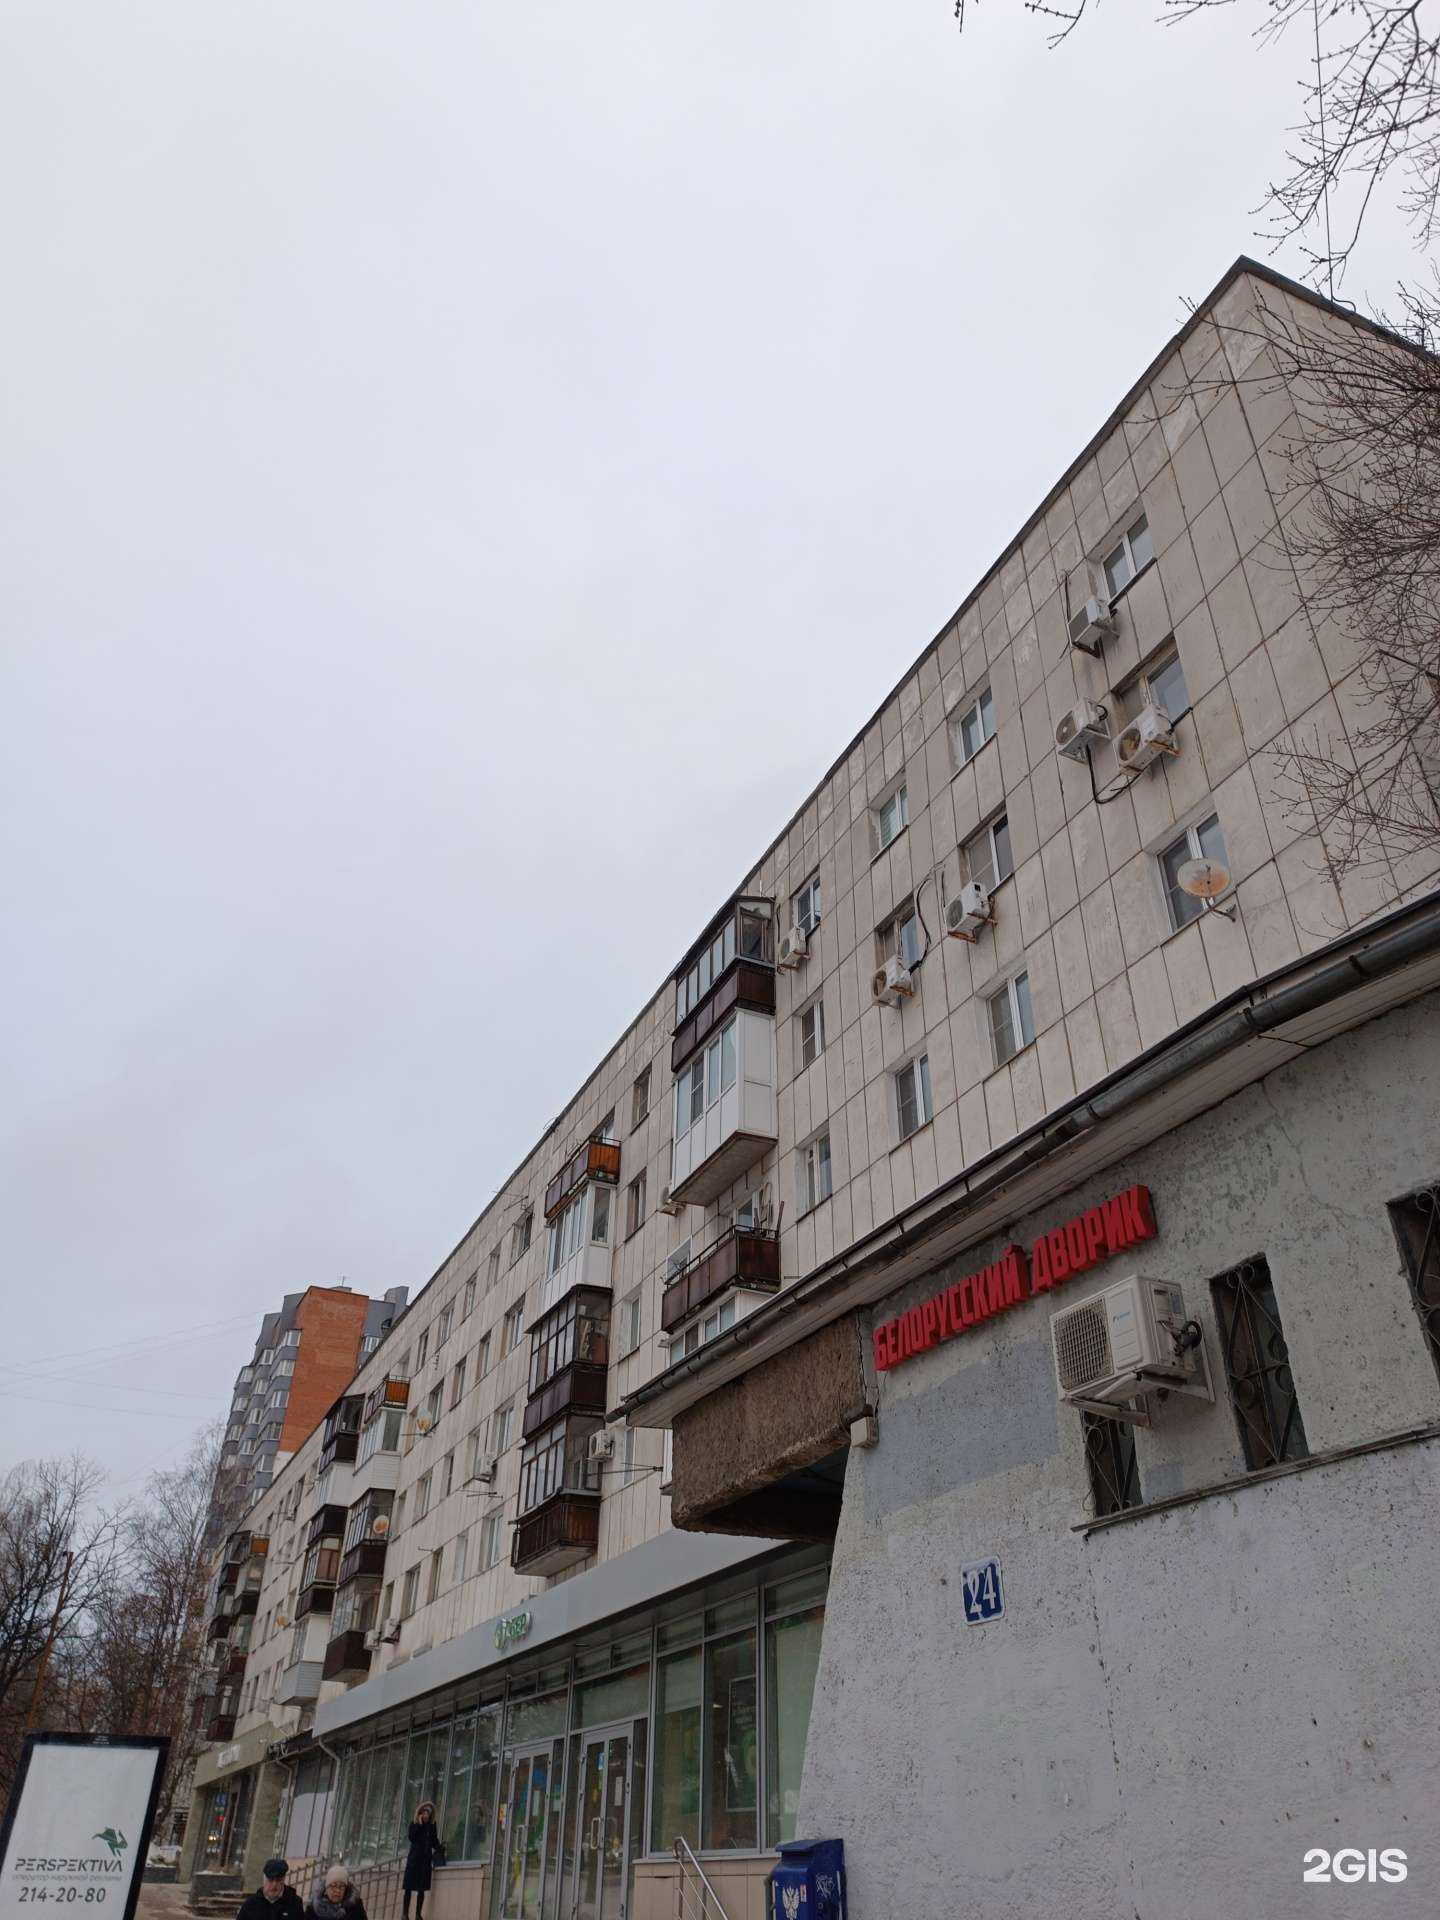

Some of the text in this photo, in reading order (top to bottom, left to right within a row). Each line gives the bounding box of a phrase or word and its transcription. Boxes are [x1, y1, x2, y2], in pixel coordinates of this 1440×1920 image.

[873, 1184, 1157, 1371] БЕЛОРУССКИЙ ДВОРИК
[966, 1566, 997, 1614] 24
[14, 1858, 123, 1872] PERSPEKTIVA
[18, 1886, 106, 1903] 214-20-80
